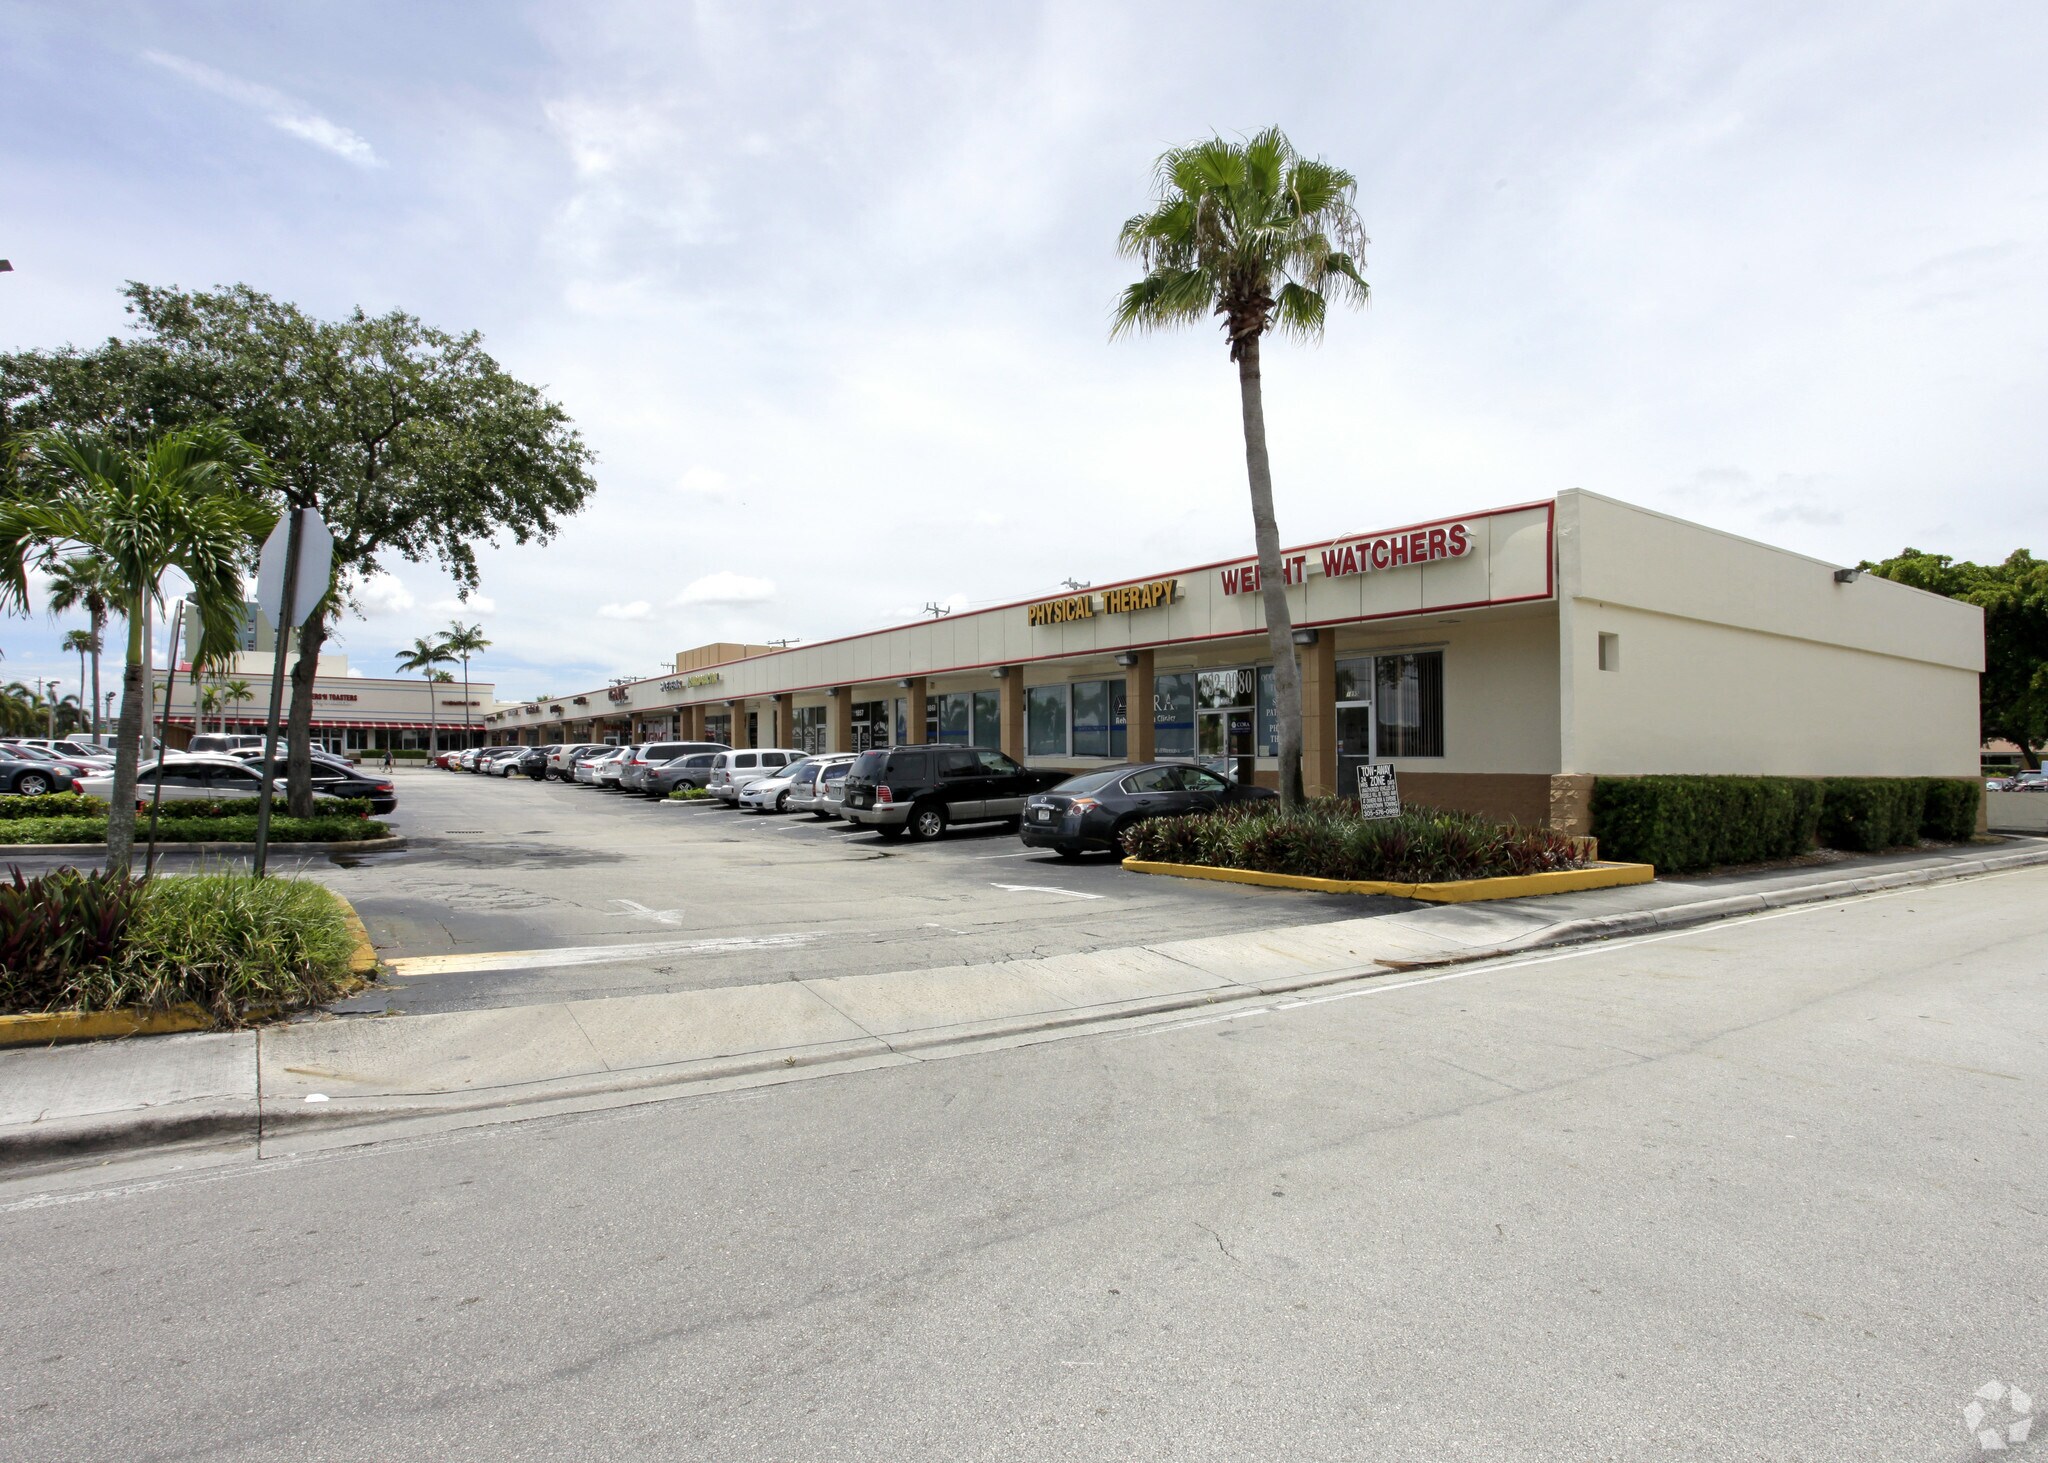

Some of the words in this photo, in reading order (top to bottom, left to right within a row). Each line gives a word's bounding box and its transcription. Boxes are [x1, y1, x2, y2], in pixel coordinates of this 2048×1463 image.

[1221, 555, 1306, 596] WEIHT
[1321, 524, 1471, 578] WATCHERS
[1028, 595, 1094, 626] PHYSICAL
[1101, 579, 1177, 615] THERAPY
[329, 694, 358, 702] TOASTERS
[1361, 765, 1391, 777] TOW-AWAY
[1370, 775, 1386, 787] ZONE
